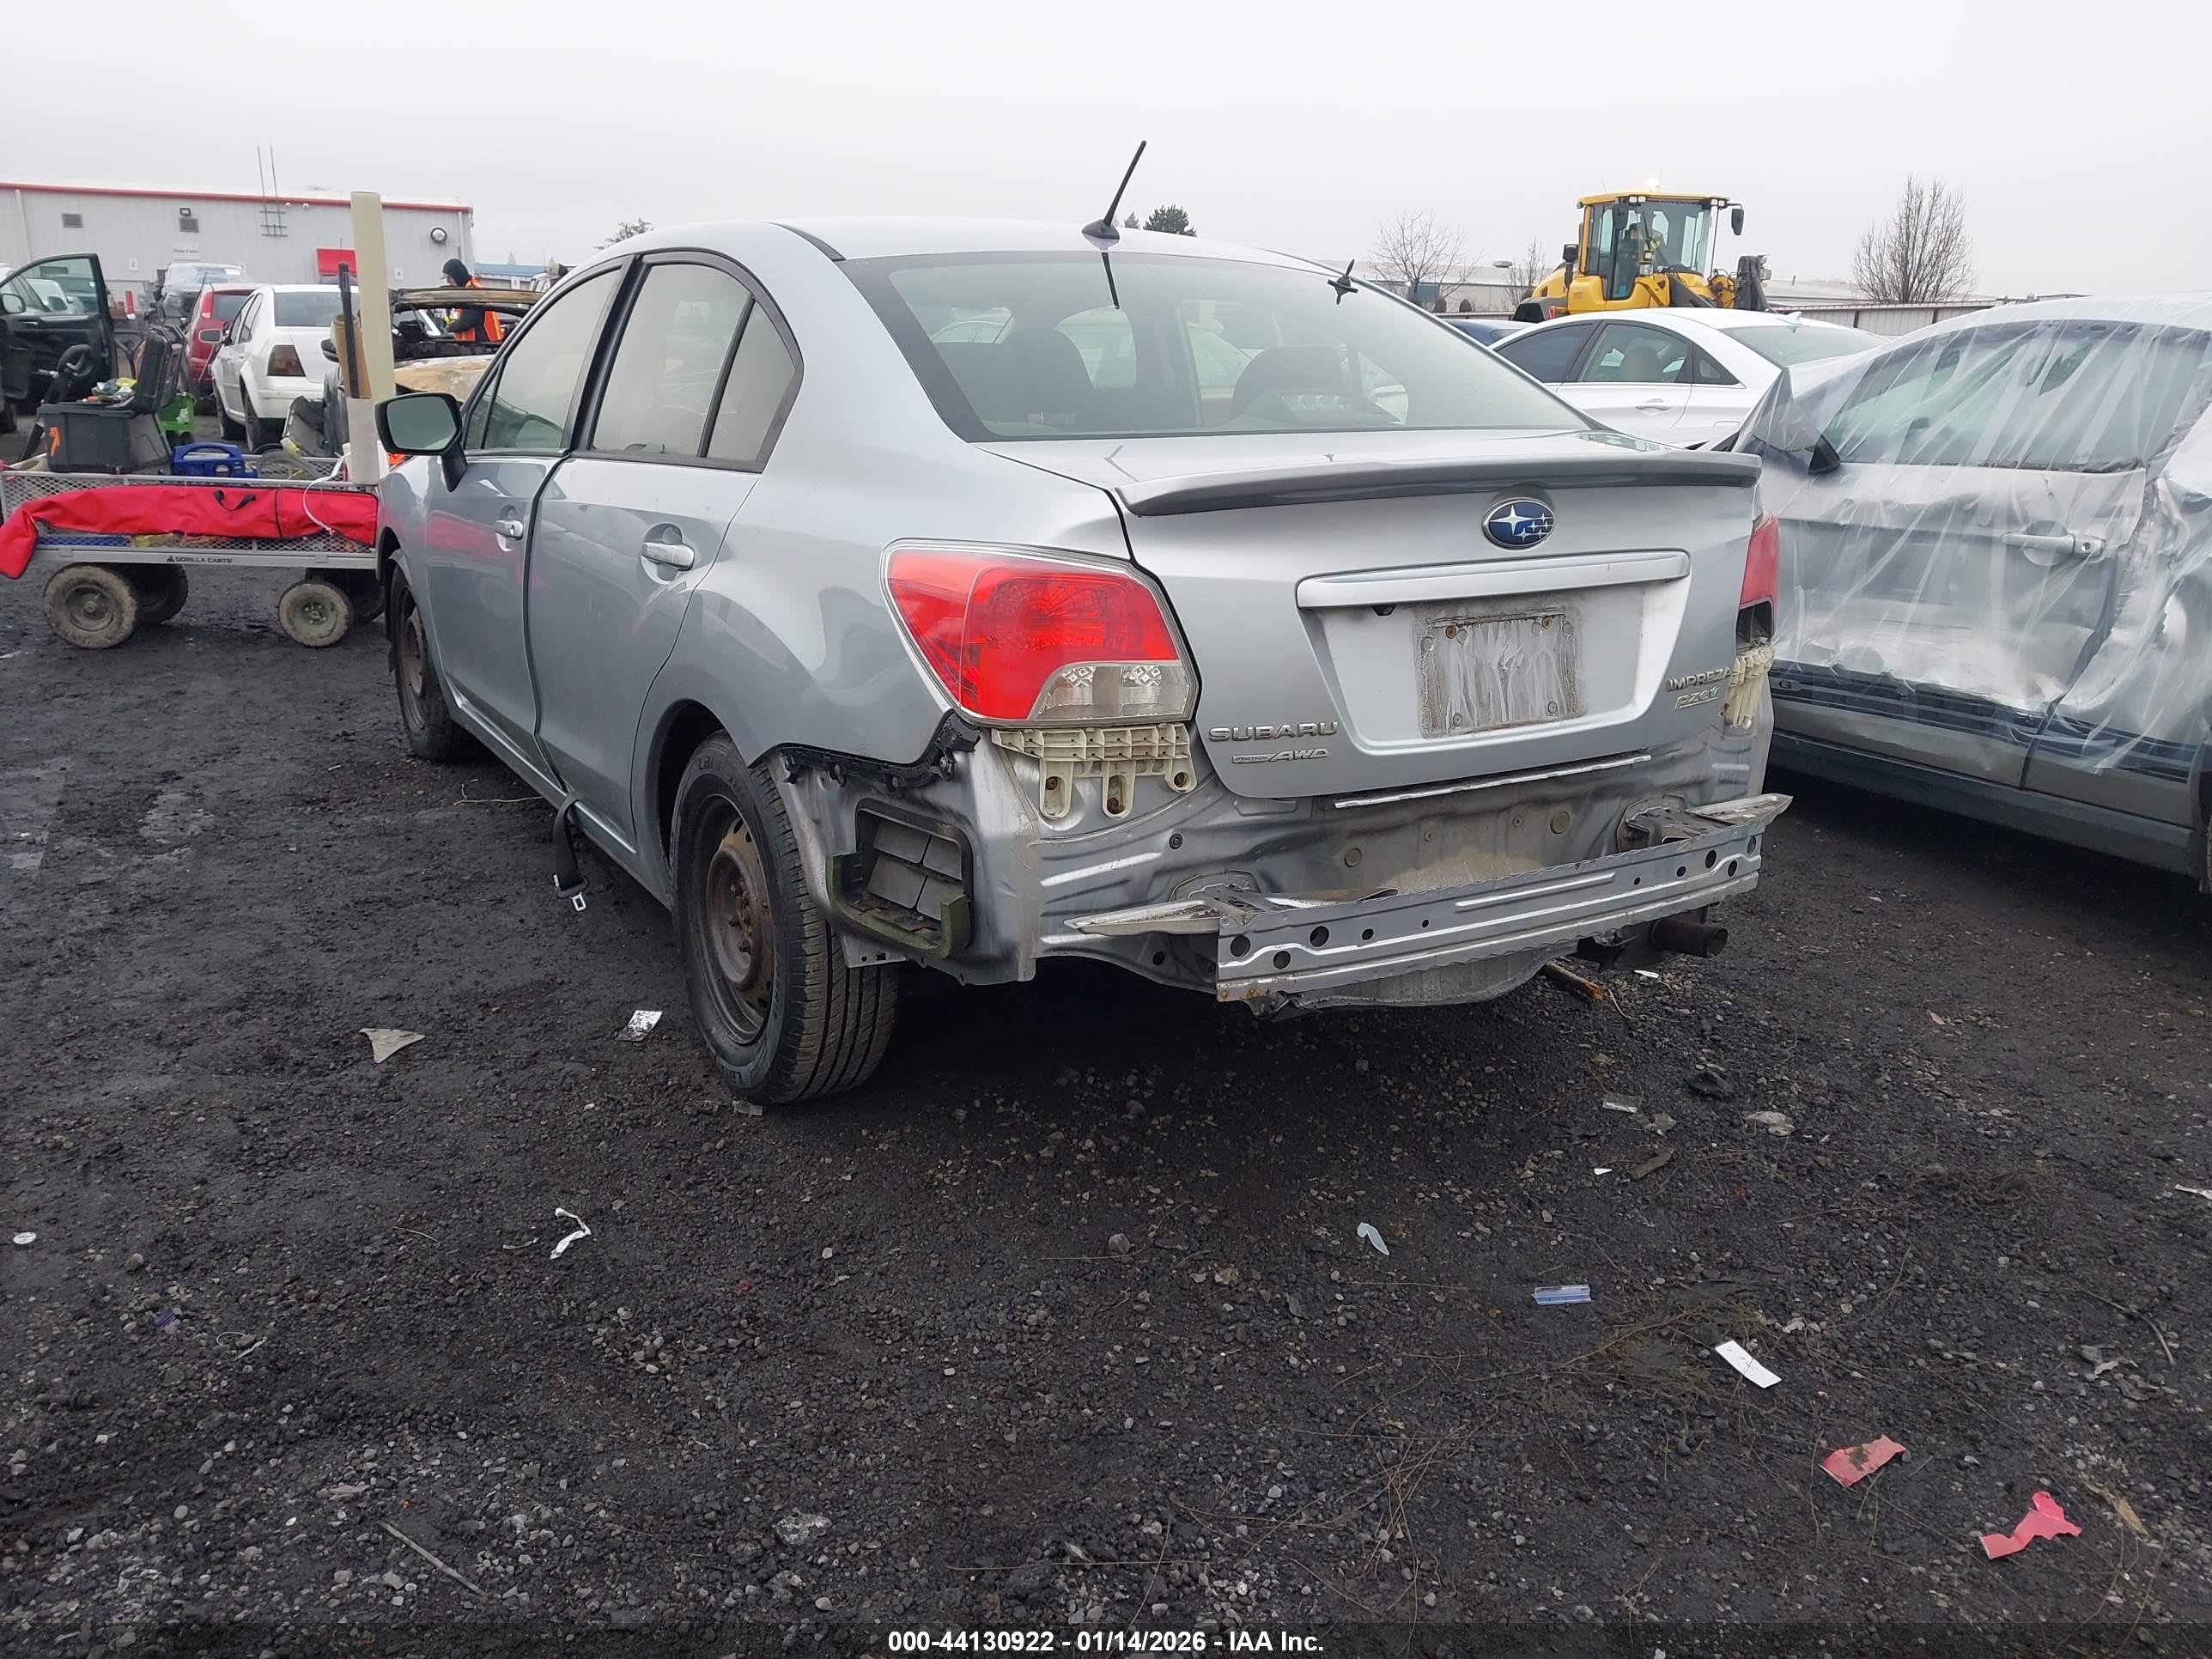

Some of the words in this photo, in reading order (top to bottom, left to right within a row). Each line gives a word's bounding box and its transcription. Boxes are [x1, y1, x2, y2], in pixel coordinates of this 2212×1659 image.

[1668, 666, 1732, 691] IMPREZA
[1209, 721, 1339, 742] SUBARU
[1271, 748, 1330, 763] AWD
